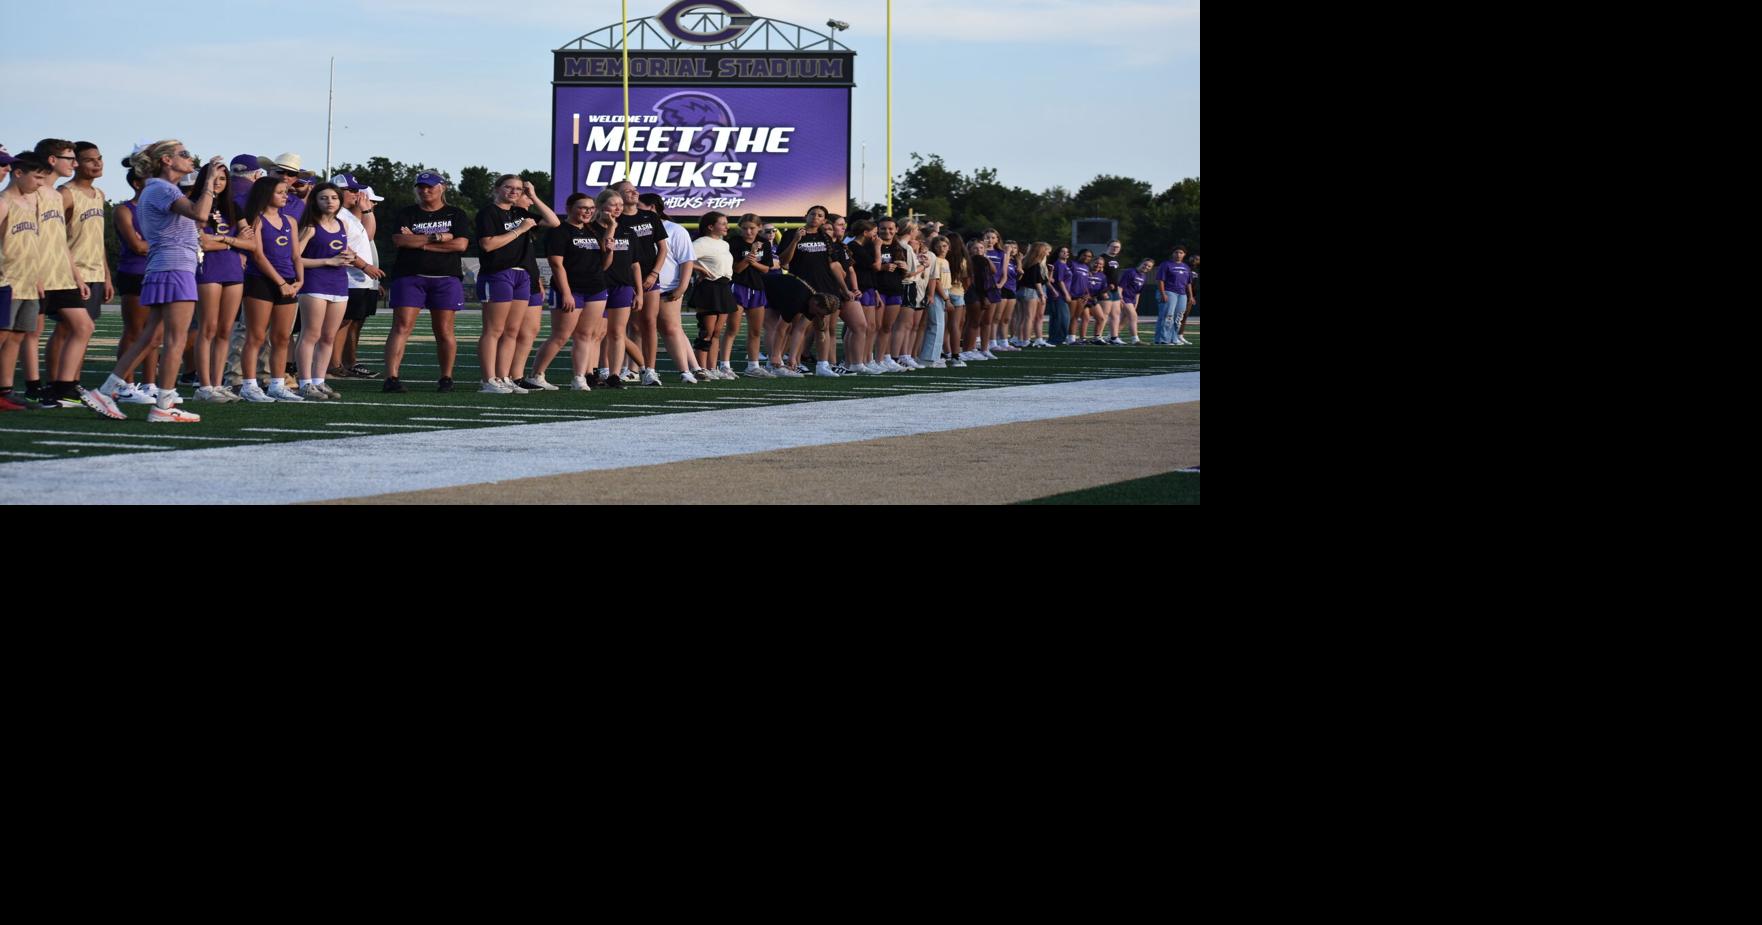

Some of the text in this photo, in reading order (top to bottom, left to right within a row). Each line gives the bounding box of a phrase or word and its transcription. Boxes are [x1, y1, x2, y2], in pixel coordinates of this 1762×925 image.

[564, 57, 843, 79] MEMORIAL STADIUM
[588, 115, 658, 123] WELCOME TO
[585, 126, 796, 153] MEET THE
[585, 161, 758, 188] CHICKS!
[661, 197, 746, 209] HICKS FIGHT
